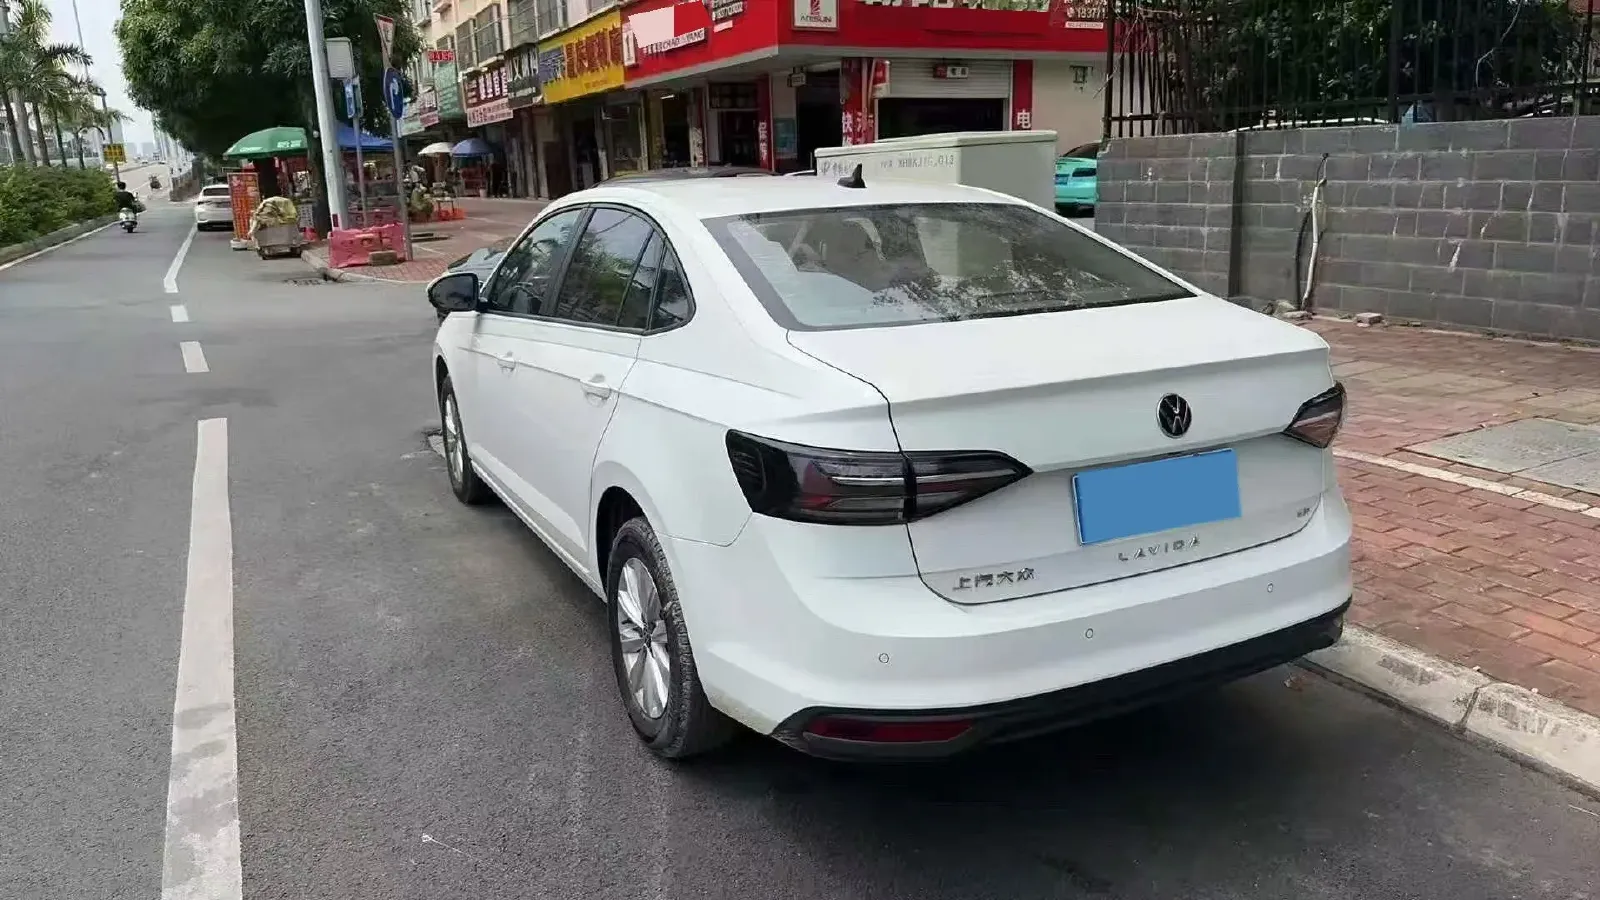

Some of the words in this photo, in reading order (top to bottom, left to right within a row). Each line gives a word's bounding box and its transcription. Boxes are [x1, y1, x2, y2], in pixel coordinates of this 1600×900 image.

[1118, 534, 1201, 561] LAVIDA
[952, 567, 1035, 591] 上汽大众
